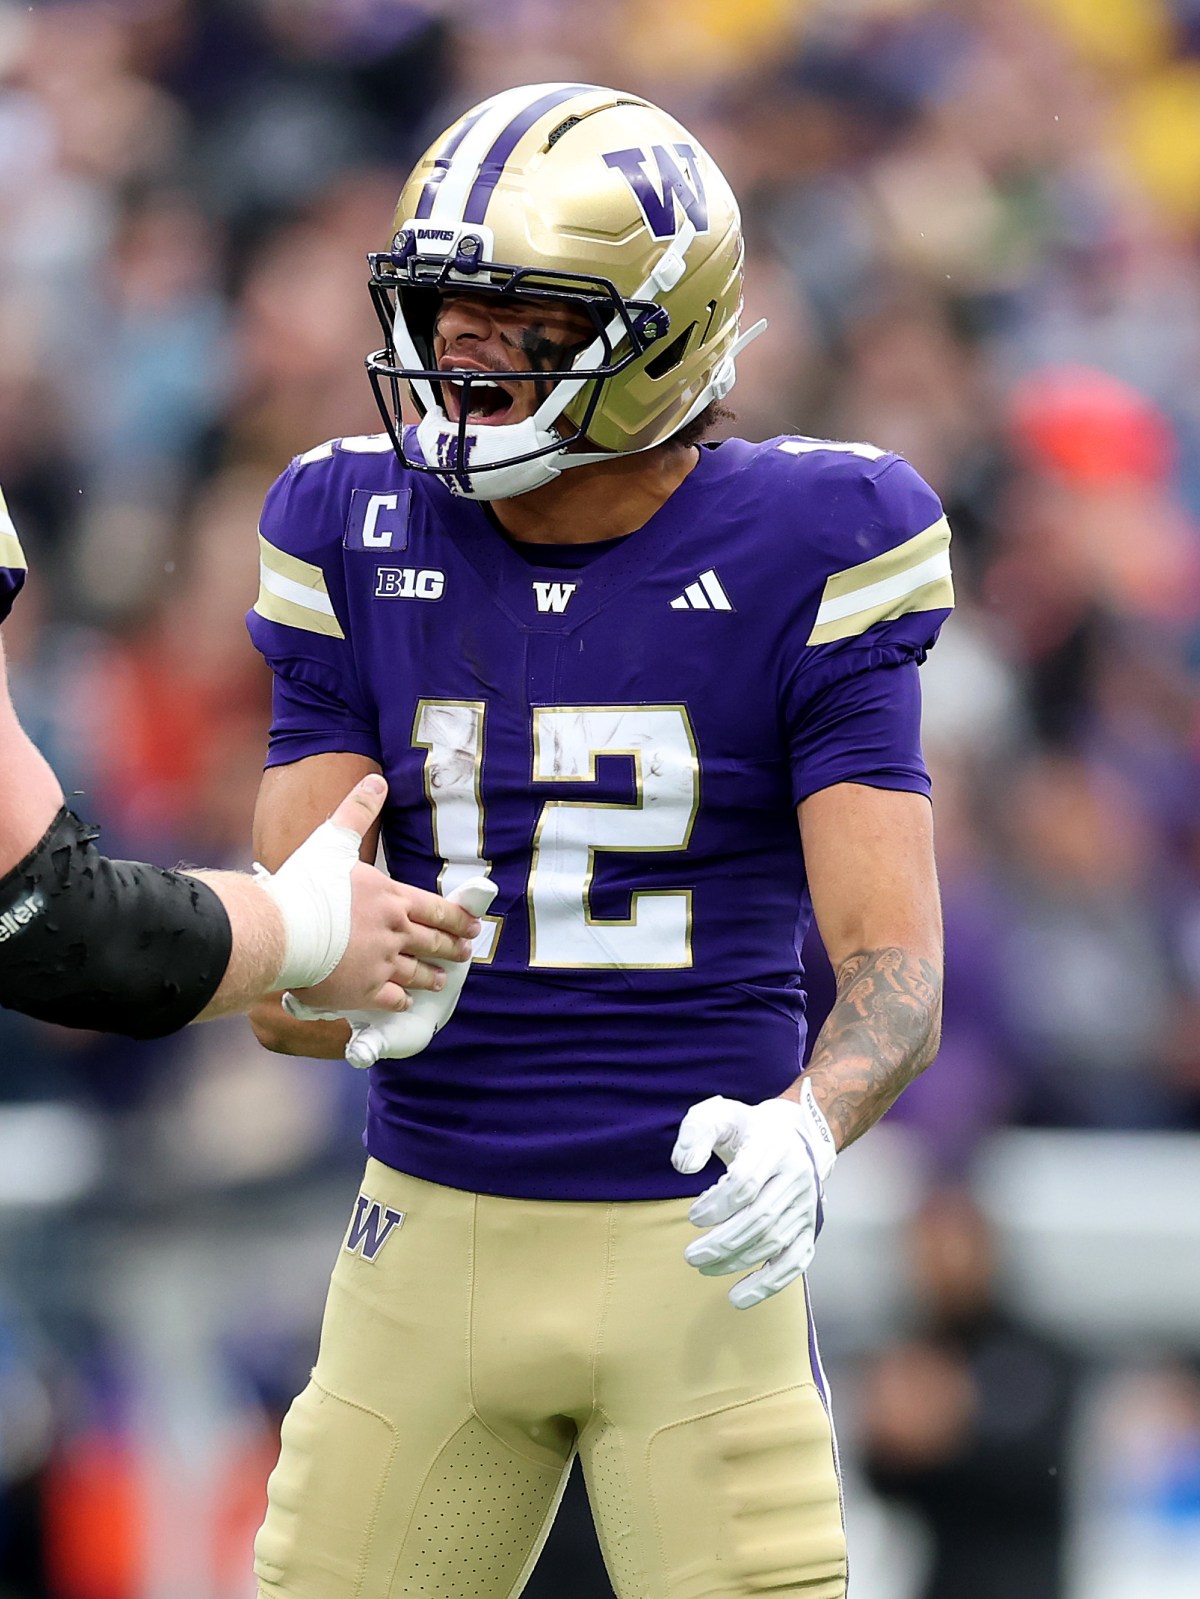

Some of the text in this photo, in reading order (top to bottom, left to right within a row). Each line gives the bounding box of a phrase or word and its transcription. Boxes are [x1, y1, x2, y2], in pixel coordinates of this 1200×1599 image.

[601, 143, 709, 238] W
[417, 228, 455, 241] DAWGS
[362, 494, 398, 548] C
[532, 582, 577, 613] W
[409, 699, 700, 968] 12
[345, 1193, 405, 1261] W
